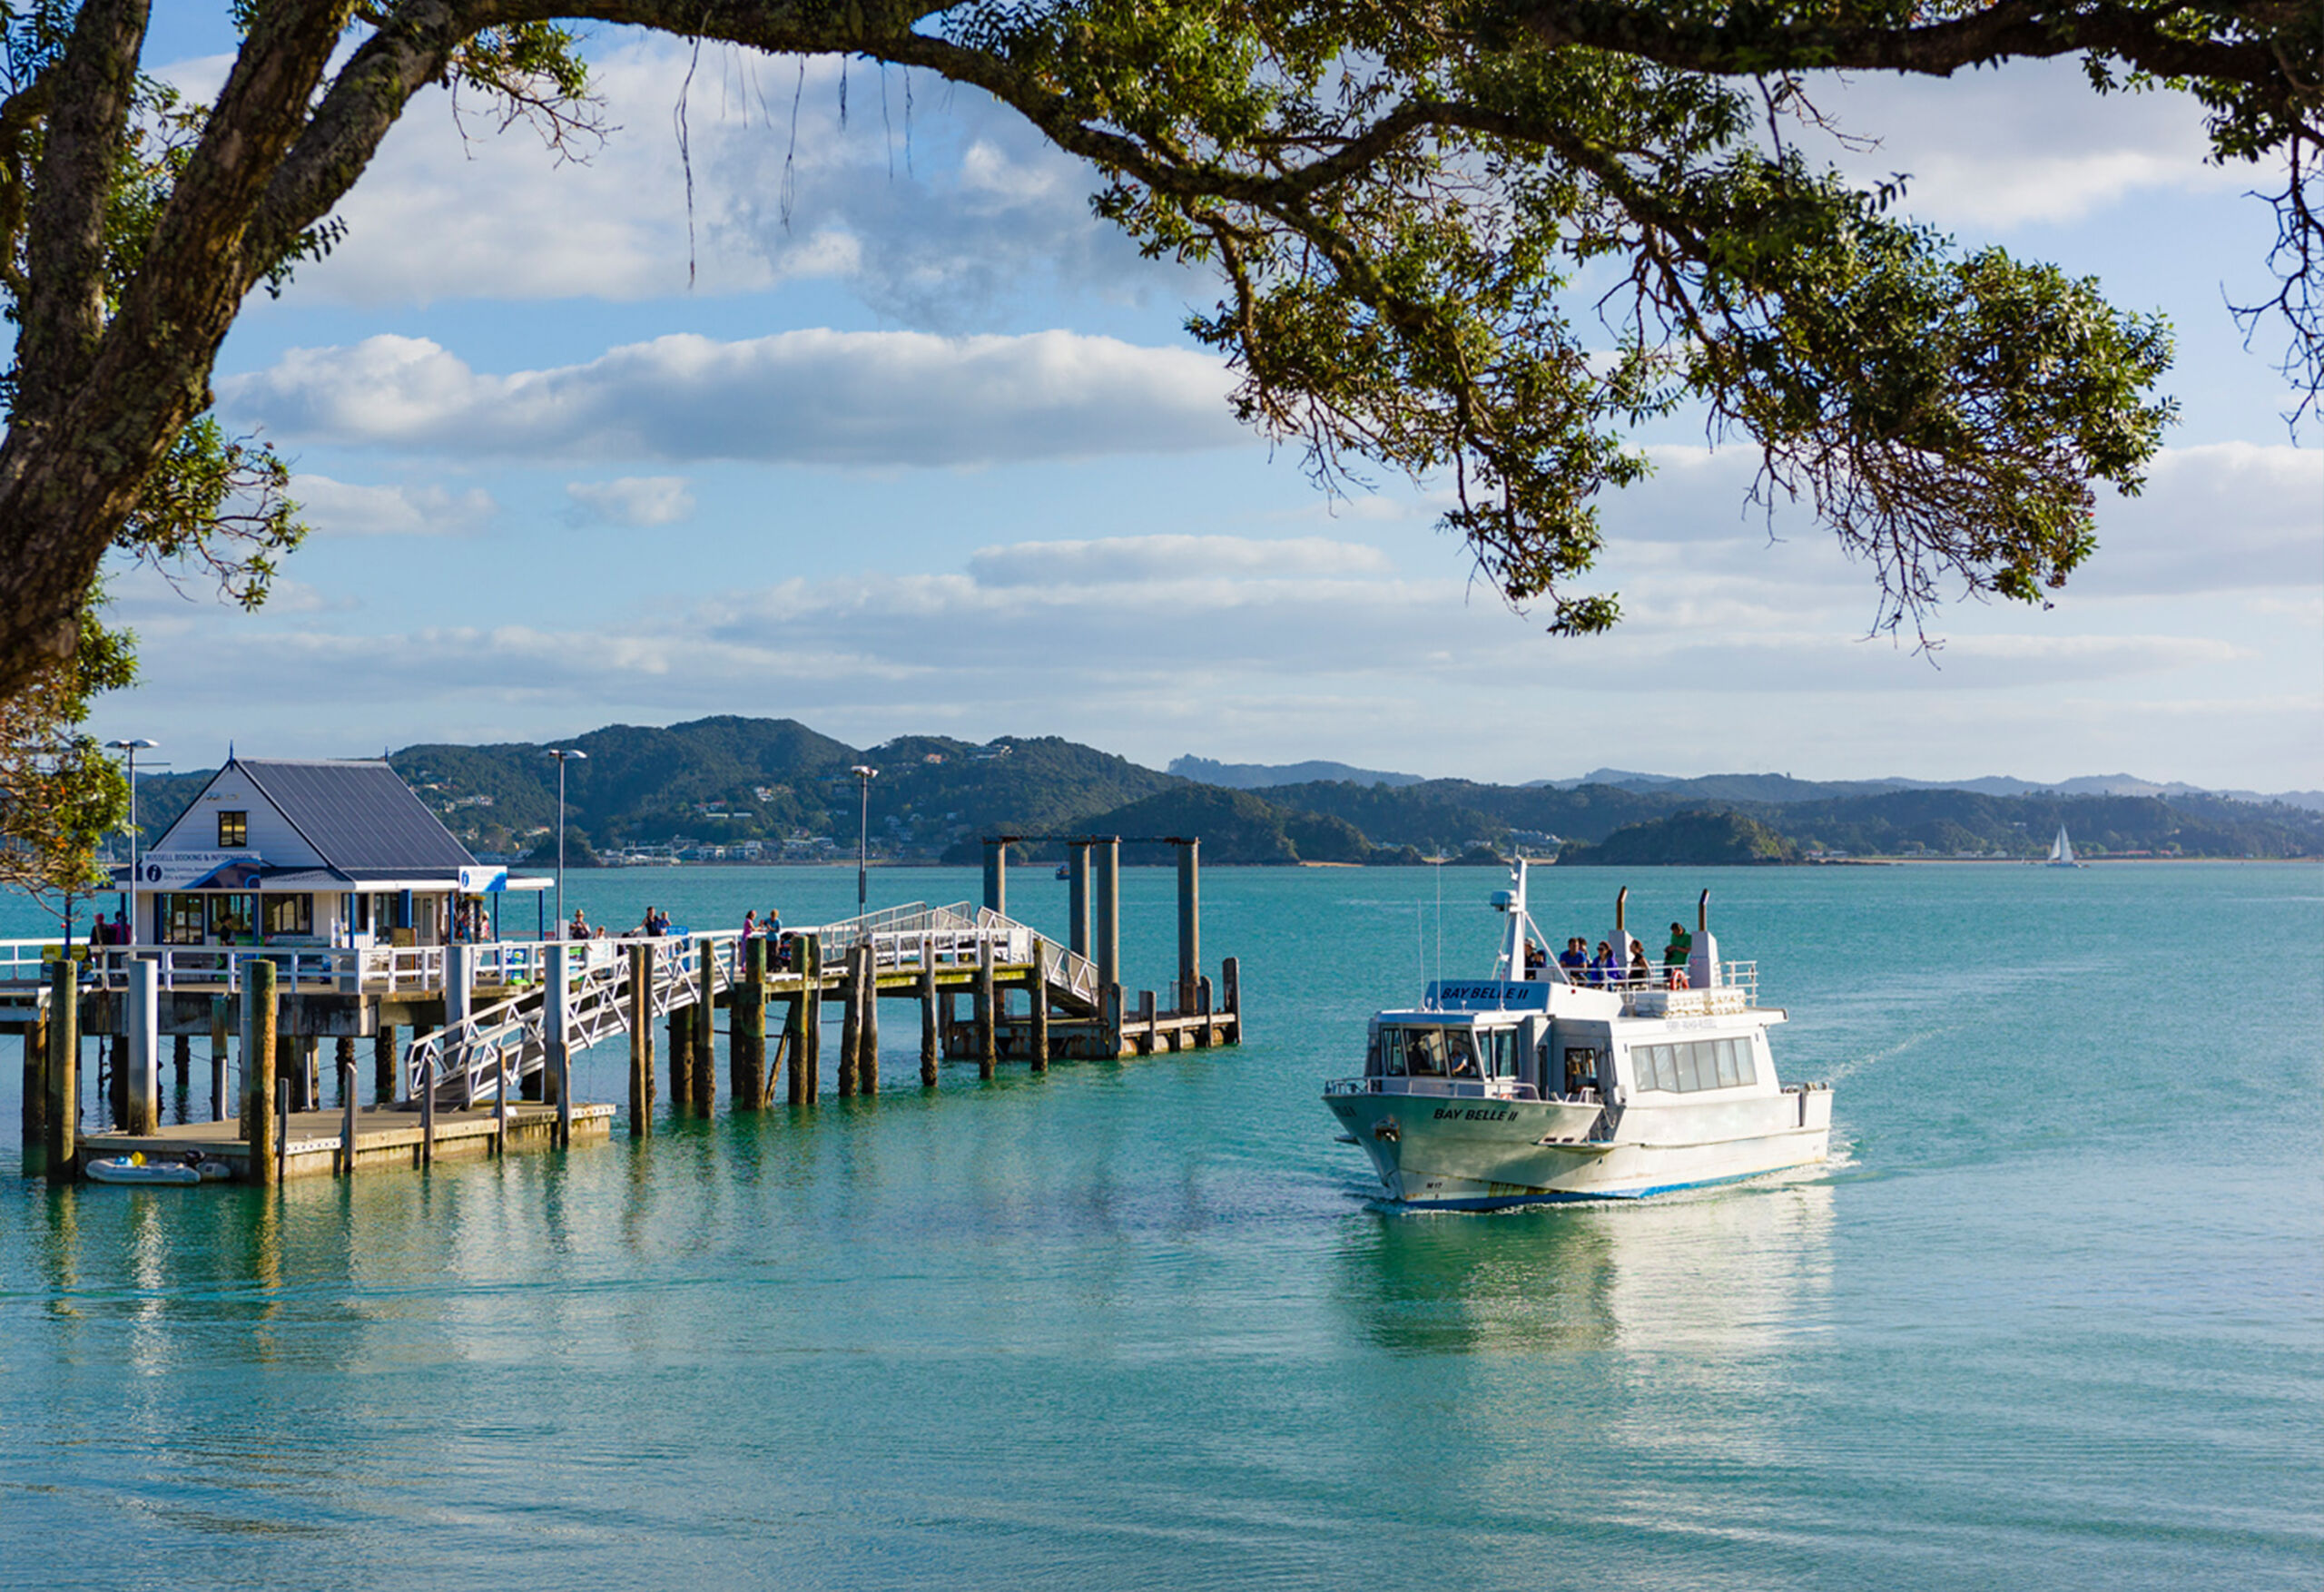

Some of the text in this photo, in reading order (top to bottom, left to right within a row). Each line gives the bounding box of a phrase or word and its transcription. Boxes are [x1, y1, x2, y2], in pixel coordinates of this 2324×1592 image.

[1441, 987, 1529, 999] BAY BELLE II
[1433, 1108, 1518, 1121] BAY BELLE II
